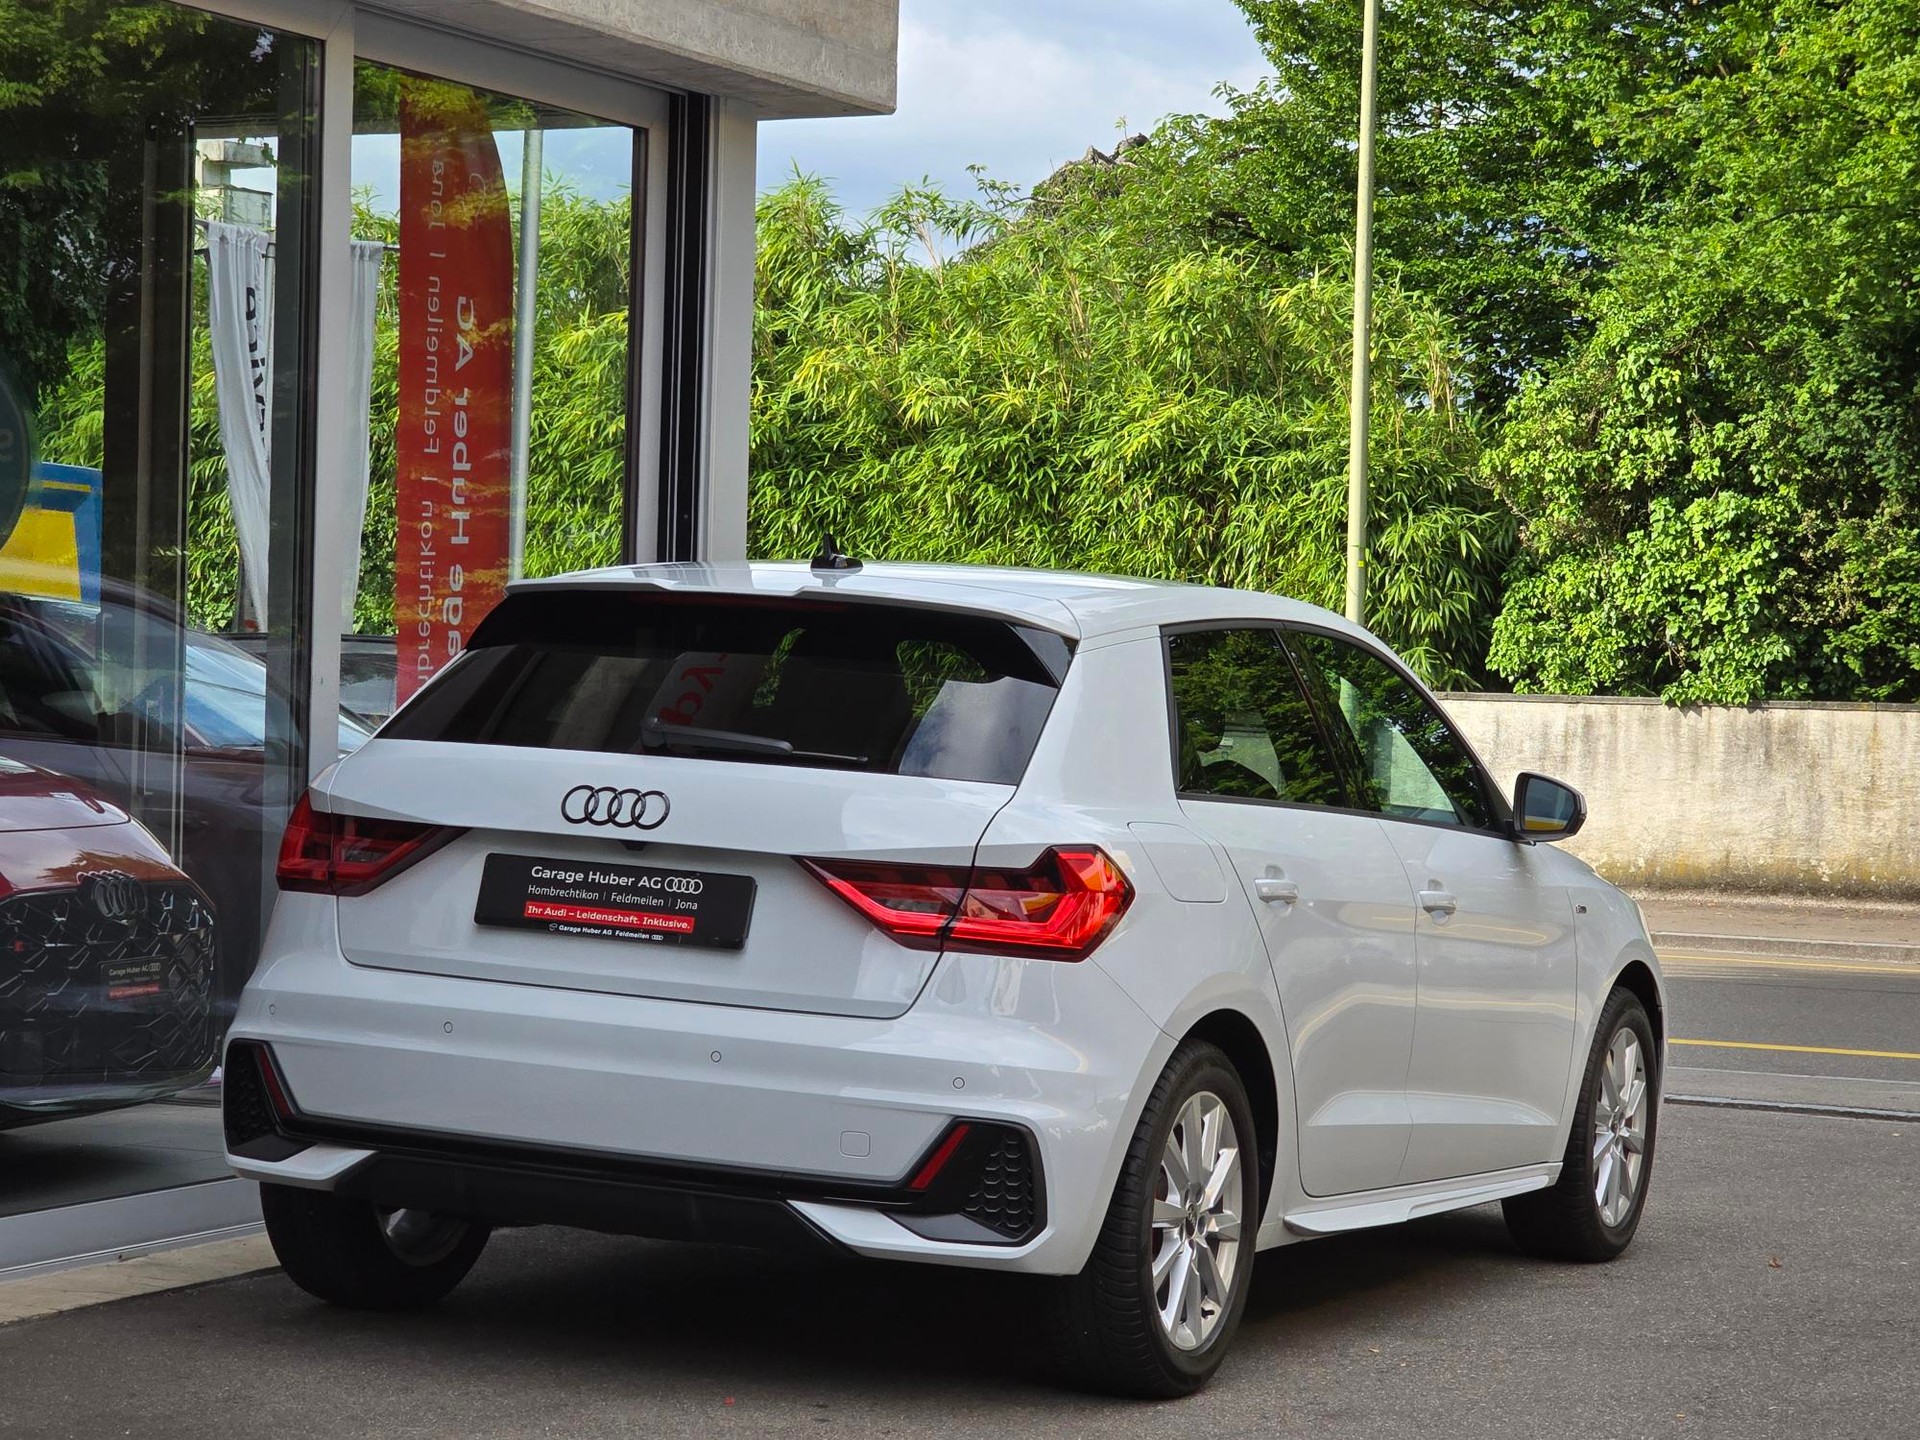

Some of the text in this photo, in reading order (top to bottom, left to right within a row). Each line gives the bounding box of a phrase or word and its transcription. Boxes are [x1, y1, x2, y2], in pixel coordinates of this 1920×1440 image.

[531, 865, 662, 889] Garage Huber AG
[527, 884, 599, 901] Hombrechtikon
[610, 892, 664, 907] Feldmeilen
[675, 899, 698, 910] Jona
[527, 905, 543, 915] Ihr
[543, 907, 567, 917] Audi
[576, 910, 641, 925] Leidenschaft.
[642, 916, 692, 930] Inklusive.
[558, 924, 582, 933] Garage
[582, 927, 602, 935] Huber
[615, 930, 650, 940] Feldmeilen
